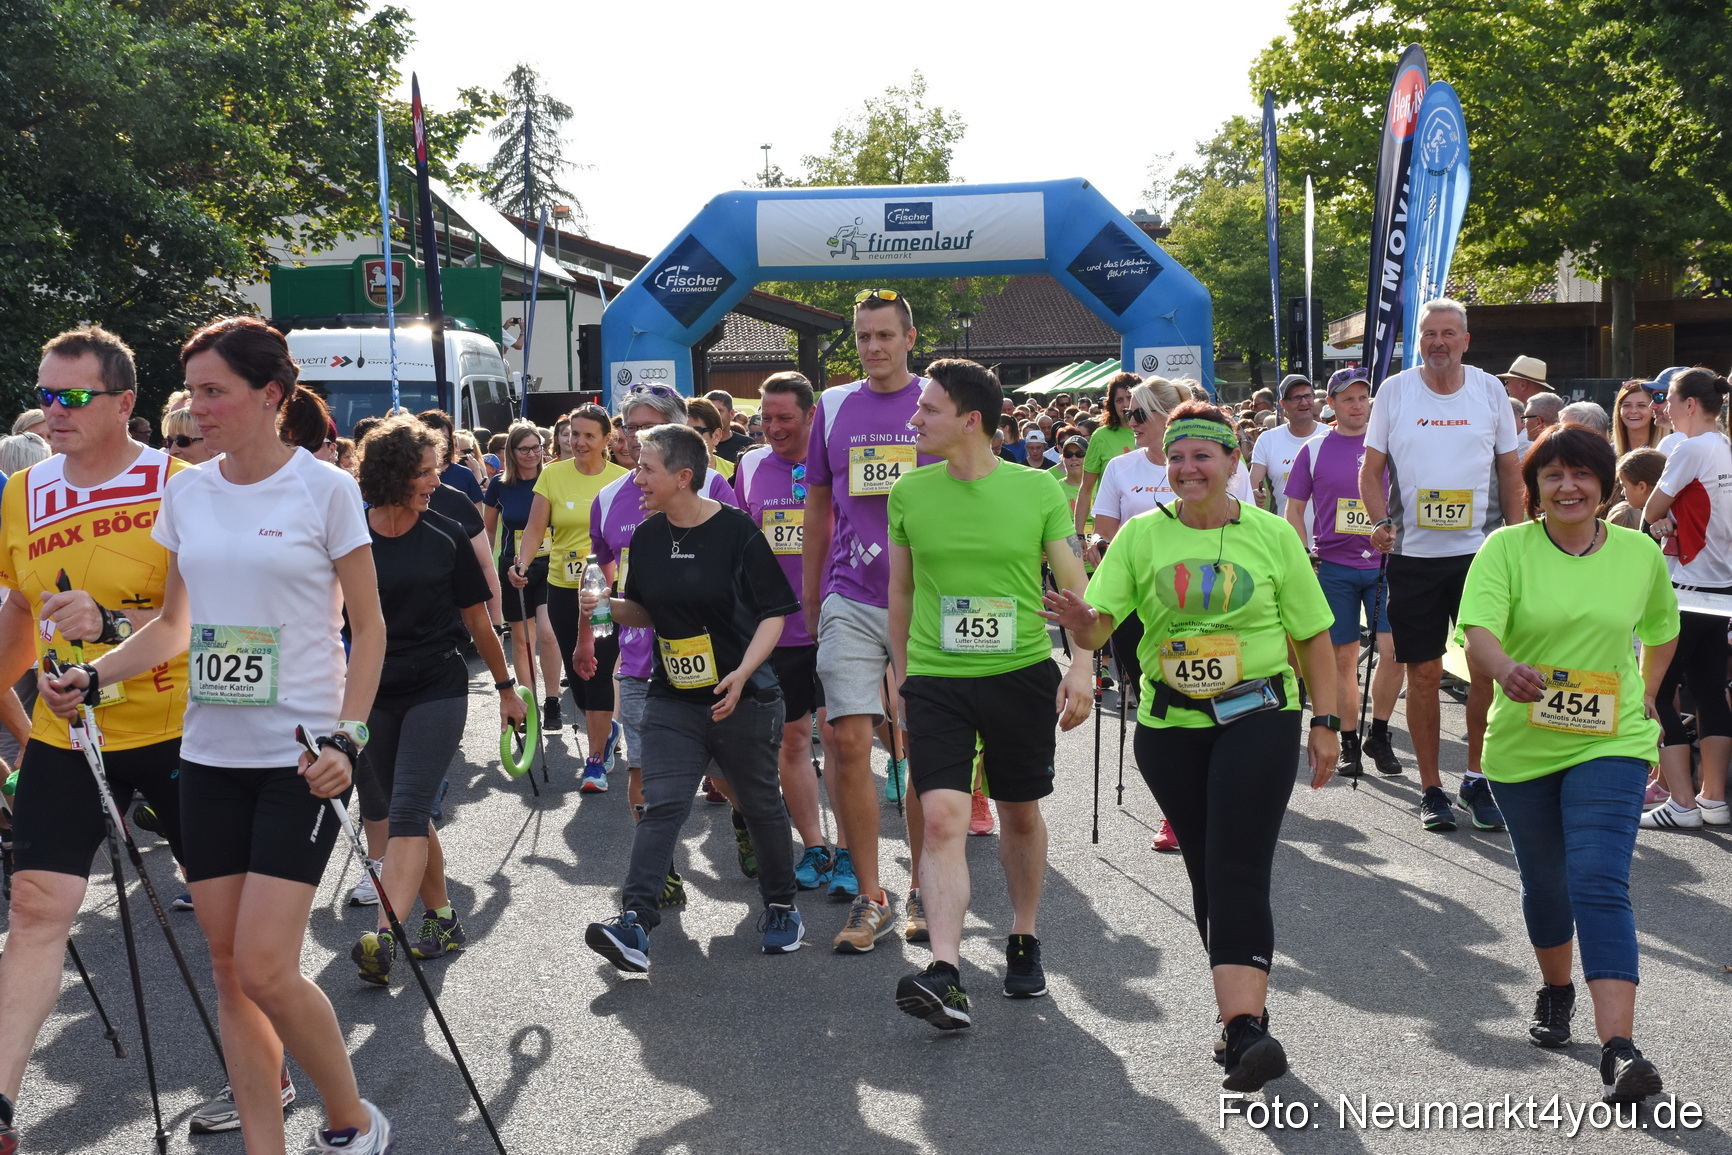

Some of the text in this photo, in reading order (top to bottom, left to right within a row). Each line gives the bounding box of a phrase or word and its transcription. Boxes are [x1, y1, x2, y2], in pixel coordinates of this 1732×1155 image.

[895, 213, 930, 222] Fischer
[868, 230, 975, 251] firmenlauf
[868, 252, 912, 260] neumarkt
[1086, 262, 1102, 272] und
[1103, 260, 1119, 269] das
[666, 273, 722, 287] Fischer
[368, 360, 435, 368] DATSPORT
[850, 433, 917, 443] WIR SIND LILA
[863, 462, 901, 482] 884
[1424, 503, 1466, 519] 1157
[258, 528, 283, 537] Katrin
[620, 523, 636, 532] WIR
[774, 525, 804, 542] 879
[28, 524, 84, 561] MAX
[955, 617, 999, 638] 453
[195, 652, 264, 683] 1025
[665, 655, 706, 675] 1980
[1175, 657, 1223, 682] 456
[229, 684, 255, 692] Katrin
[1547, 690, 1600, 718] 454
[1540, 711, 1606, 726] Maniotis Alexandra
